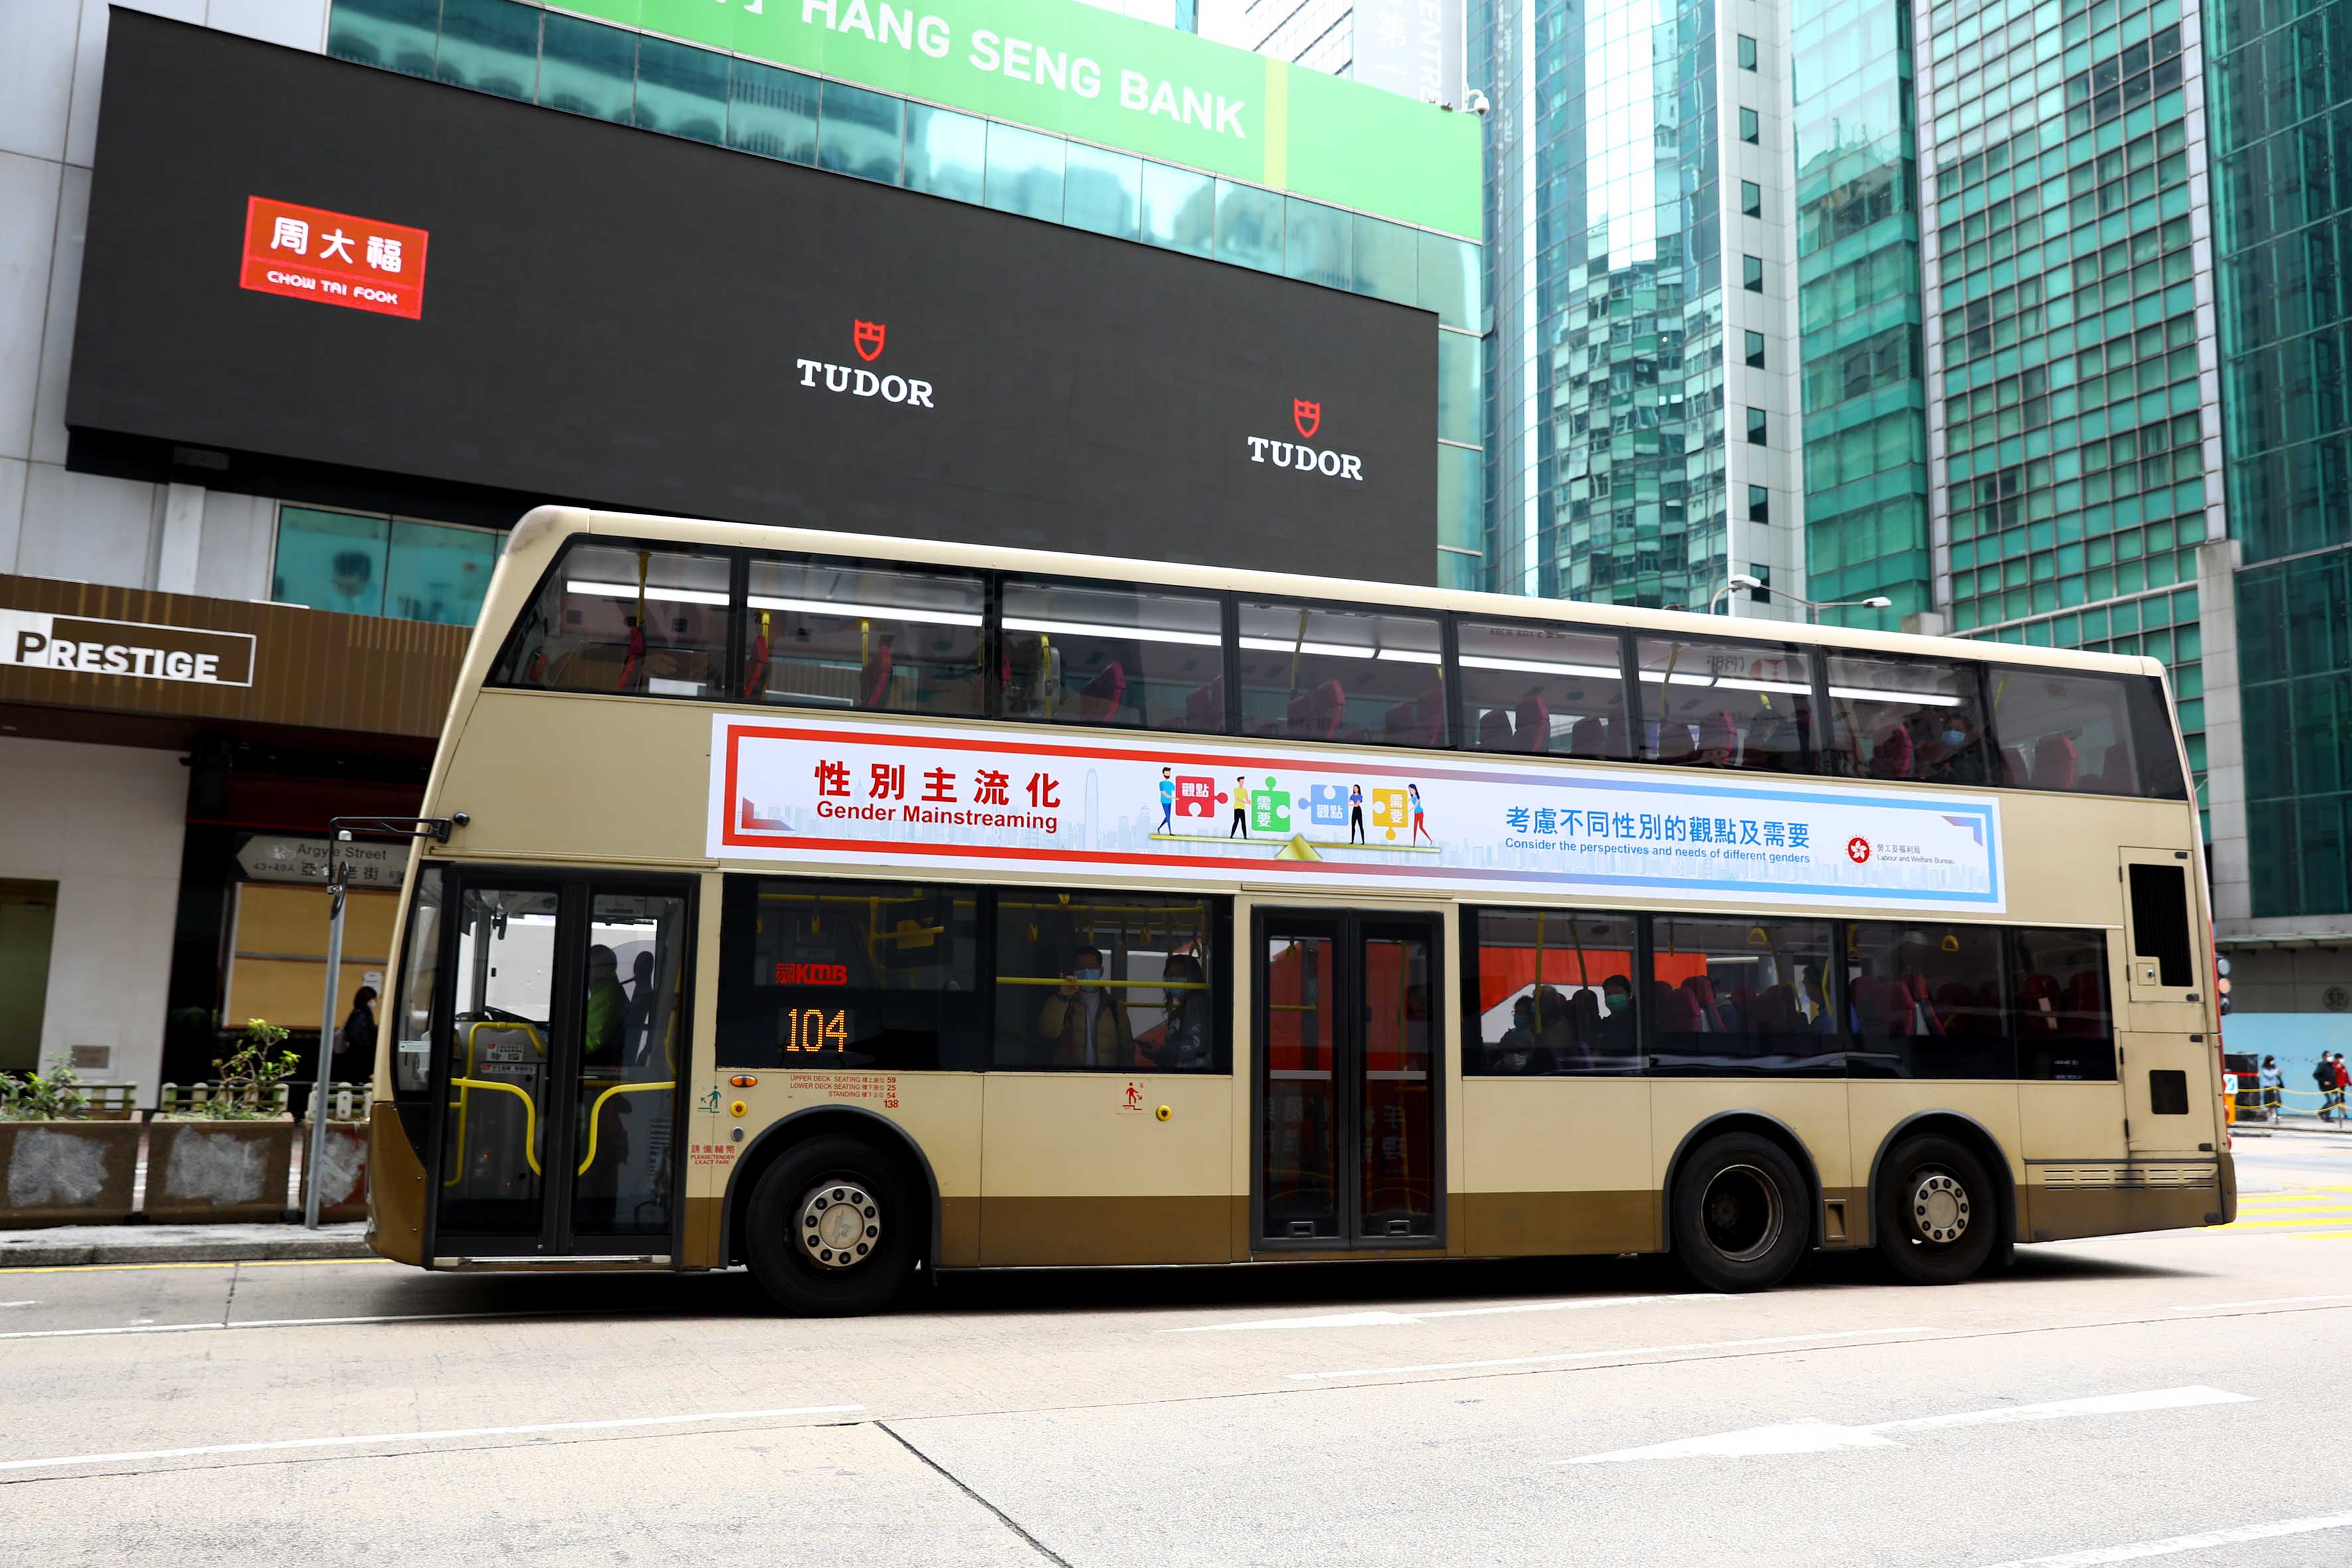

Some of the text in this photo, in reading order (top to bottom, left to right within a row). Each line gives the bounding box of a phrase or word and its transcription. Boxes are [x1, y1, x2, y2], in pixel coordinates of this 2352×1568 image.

[802, 0, 1246, 139] HANG SENG BANK
[270, 216, 402, 273] 周大福
[267, 270, 398, 305] CHOW TAI FOOK
[797, 358, 934, 408] TUDOR
[1247, 435, 1363, 481] TUDOR
[15, 631, 220, 681] PRESTIGE
[815, 759, 1061, 808] 性別主流化
[1182, 782, 1210, 798] 觀點
[817, 801, 1058, 834] Gender Mainstreaming
[1257, 795, 1271, 828] 需要
[1316, 804, 1343, 820] 觀點
[1389, 793, 1403, 824] 需要
[1506, 806, 1810, 848] 考慮不同性別的觀點及需要
[297, 844, 386, 860] Argye Street
[1505, 838, 1810, 864] Consider the perspectives and needs of different genders
[787, 1008, 848, 1053] 104
[883, 1099, 899, 1109] 138
